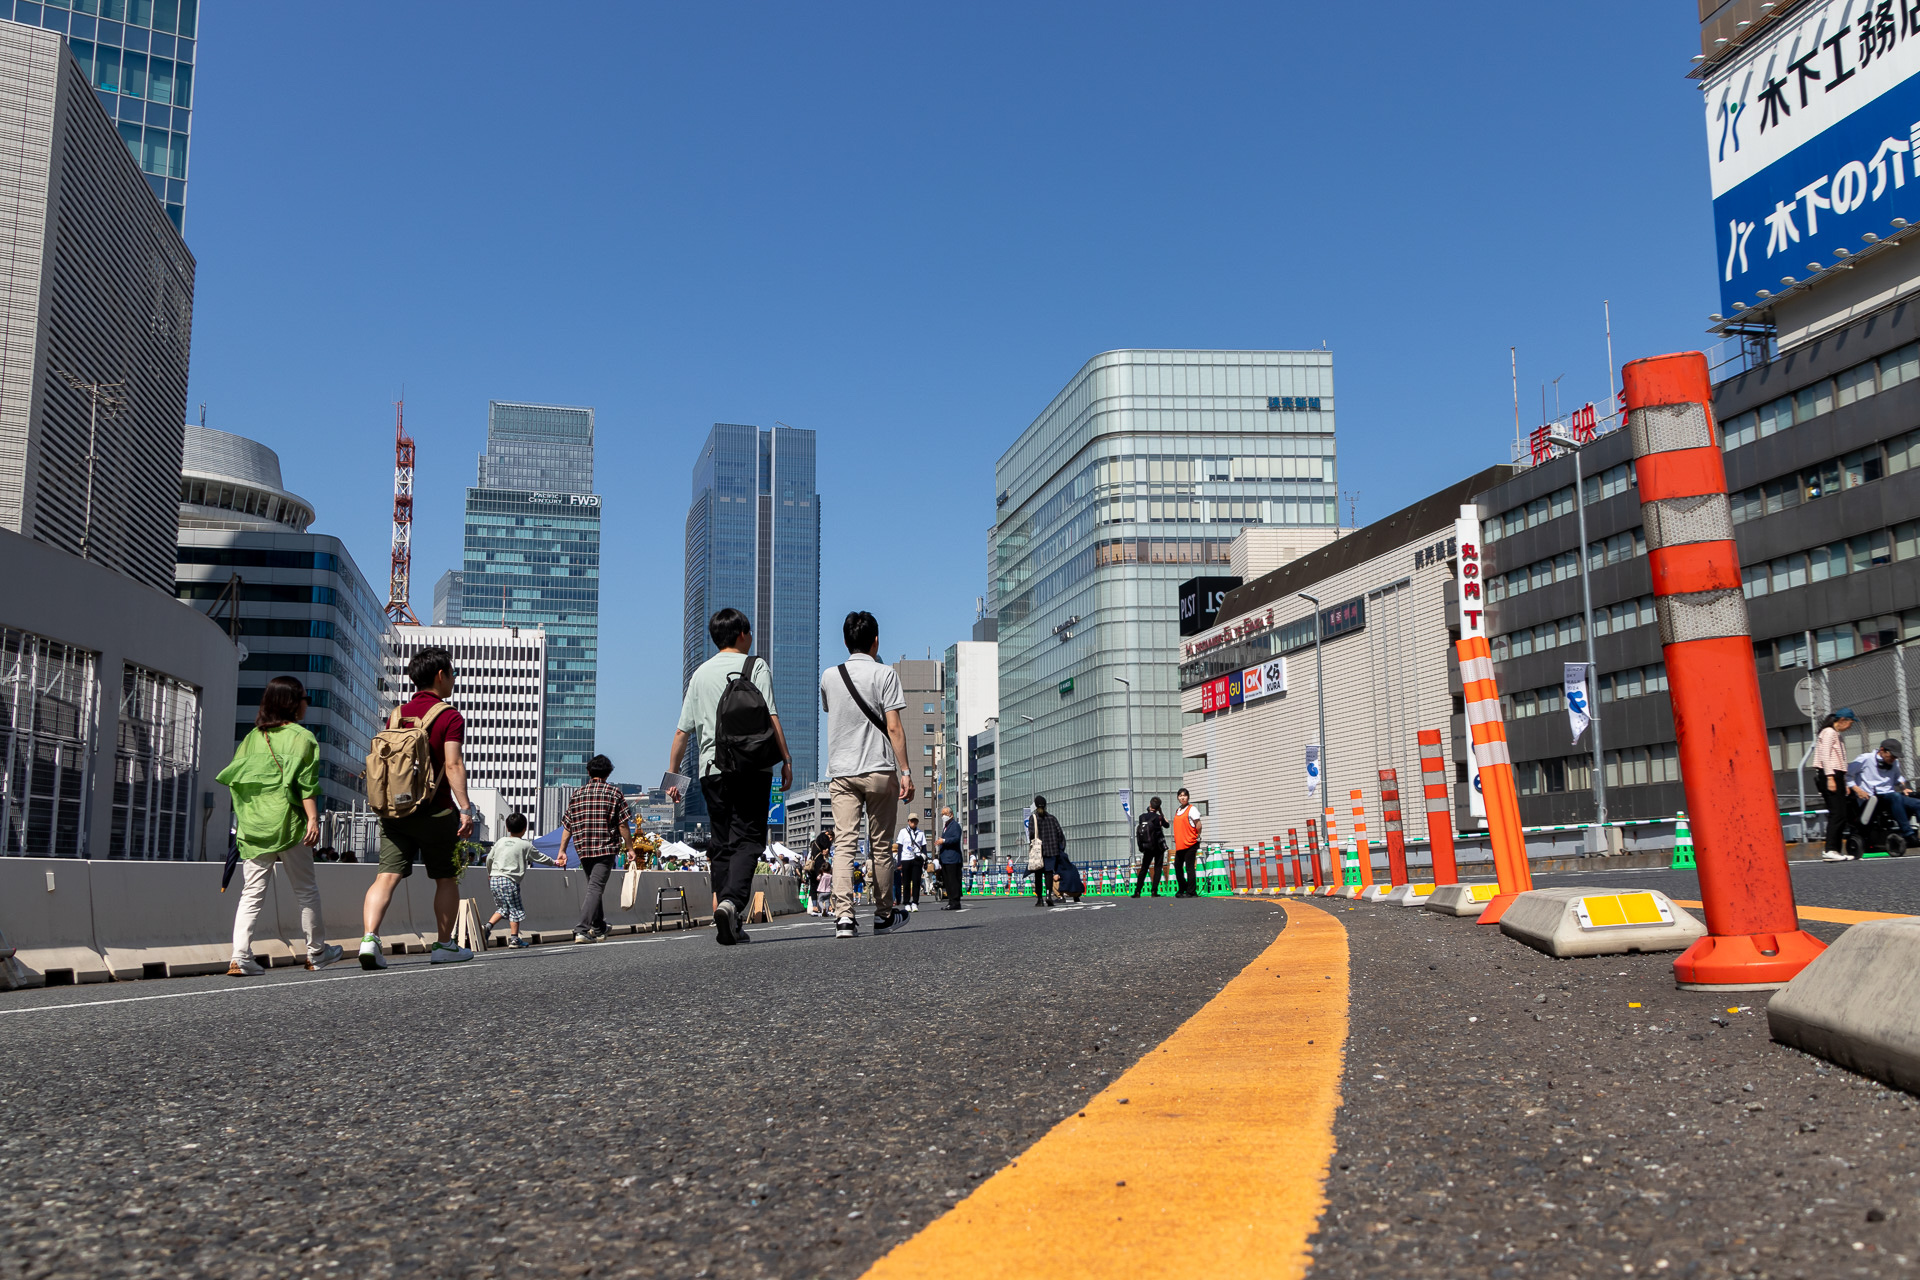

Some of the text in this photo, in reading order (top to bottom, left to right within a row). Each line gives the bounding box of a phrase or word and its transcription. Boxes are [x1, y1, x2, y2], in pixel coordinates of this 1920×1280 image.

[1764, 121, 1920, 259] 木下の介
[570, 495, 599, 506] FWD
[1461, 543, 1479, 599] 丸の内
[1180, 593, 1196, 620] PLST
[1245, 669, 1262, 689] OK
[1266, 664, 1280, 682] くら
[1203, 685, 1212, 697] ユニ
[1215, 681, 1225, 694] UNI
[1229, 681, 1241, 697] GU
[1266, 681, 1281, 692] KURA
[1203, 697, 1213, 710] クロ
[1215, 693, 1226, 707] QLO
